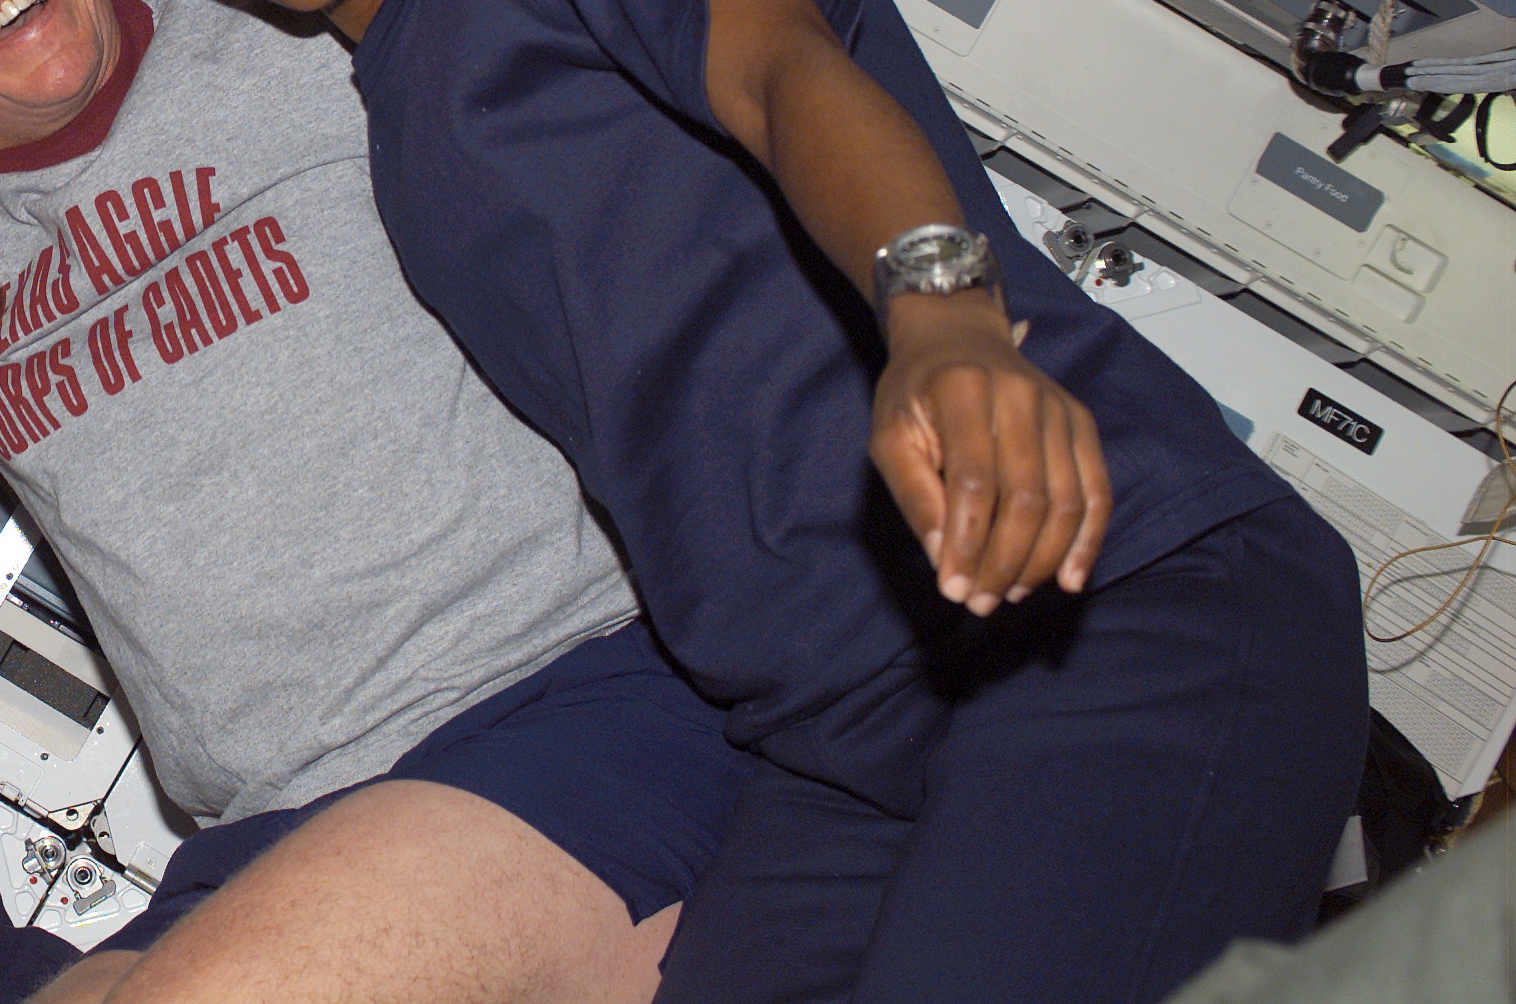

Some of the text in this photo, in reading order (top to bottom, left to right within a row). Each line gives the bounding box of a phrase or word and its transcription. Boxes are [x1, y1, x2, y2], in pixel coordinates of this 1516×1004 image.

[1325, 184, 1349, 202] Food
[88, 304, 142, 396] OF
[142, 216, 310, 365] CADETS
[1309, 399, 1370, 443] MF71C
